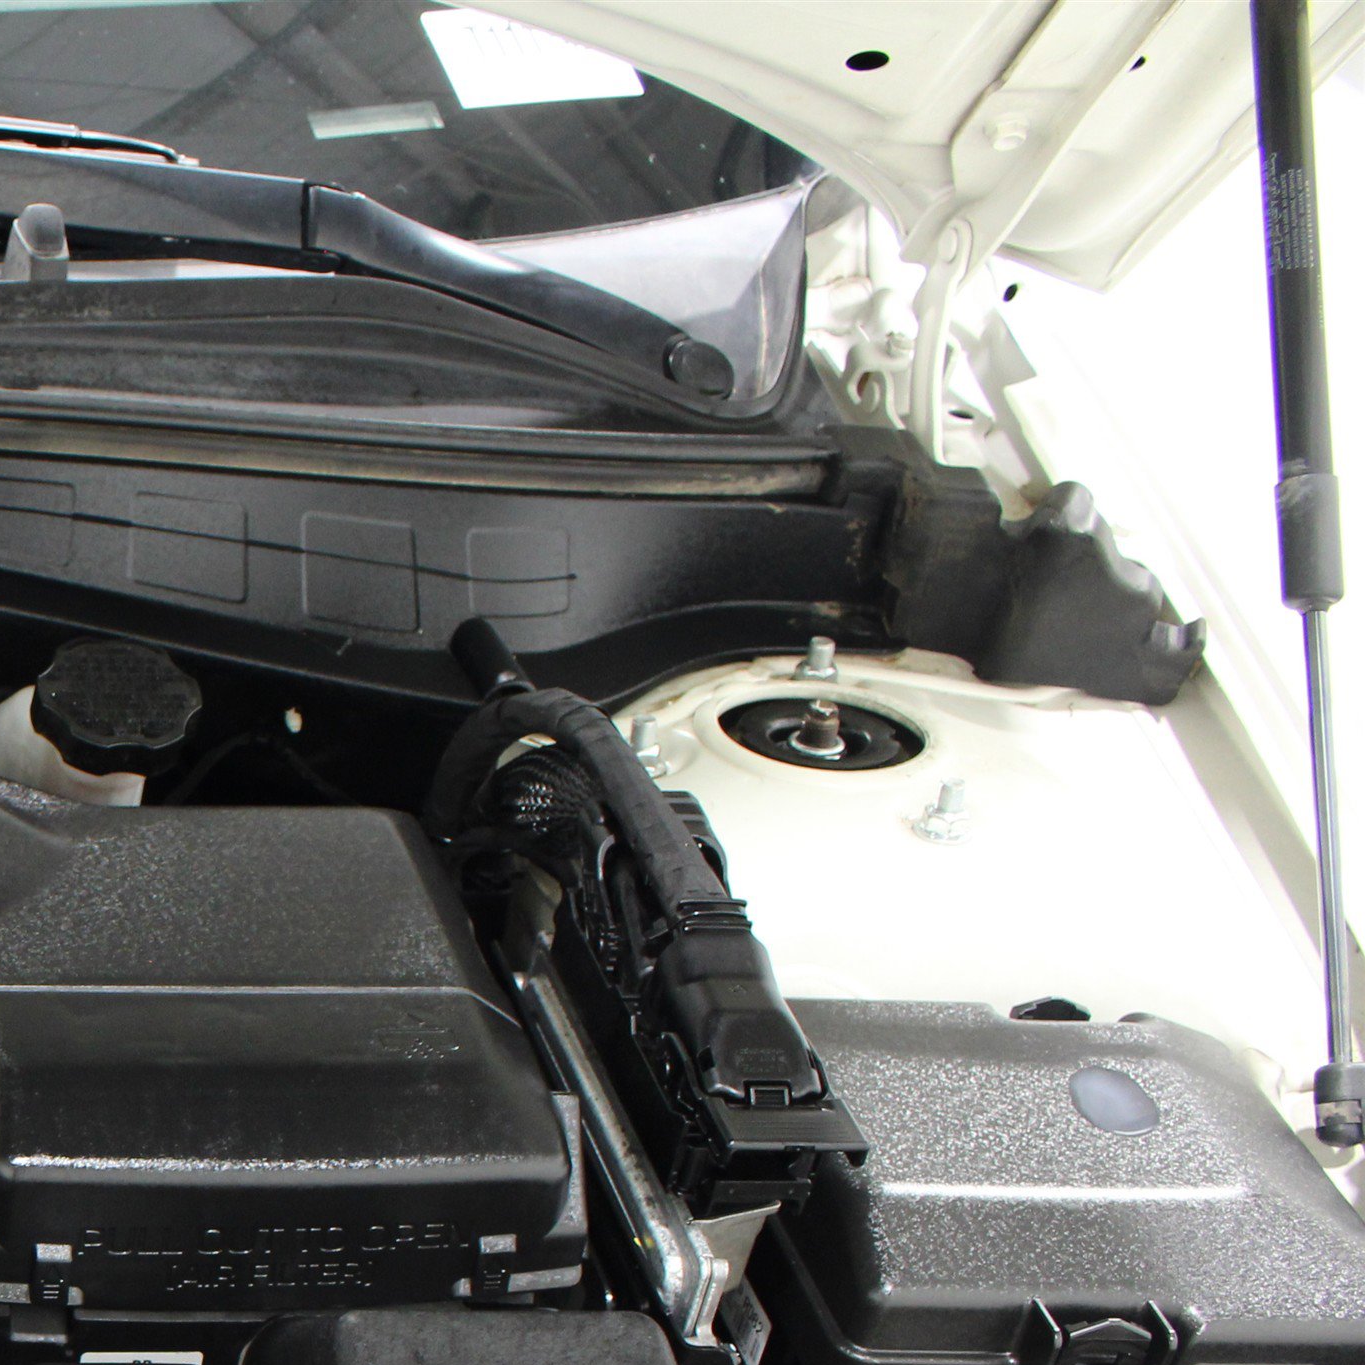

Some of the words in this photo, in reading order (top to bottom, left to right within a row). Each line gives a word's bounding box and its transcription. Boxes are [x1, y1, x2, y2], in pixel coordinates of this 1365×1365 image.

[77, 1229, 183, 1256] PULL
[197, 1229, 285, 1255] OUT
[295, 1228, 344, 1254] TO
[360, 1224, 470, 1252] OPEN
